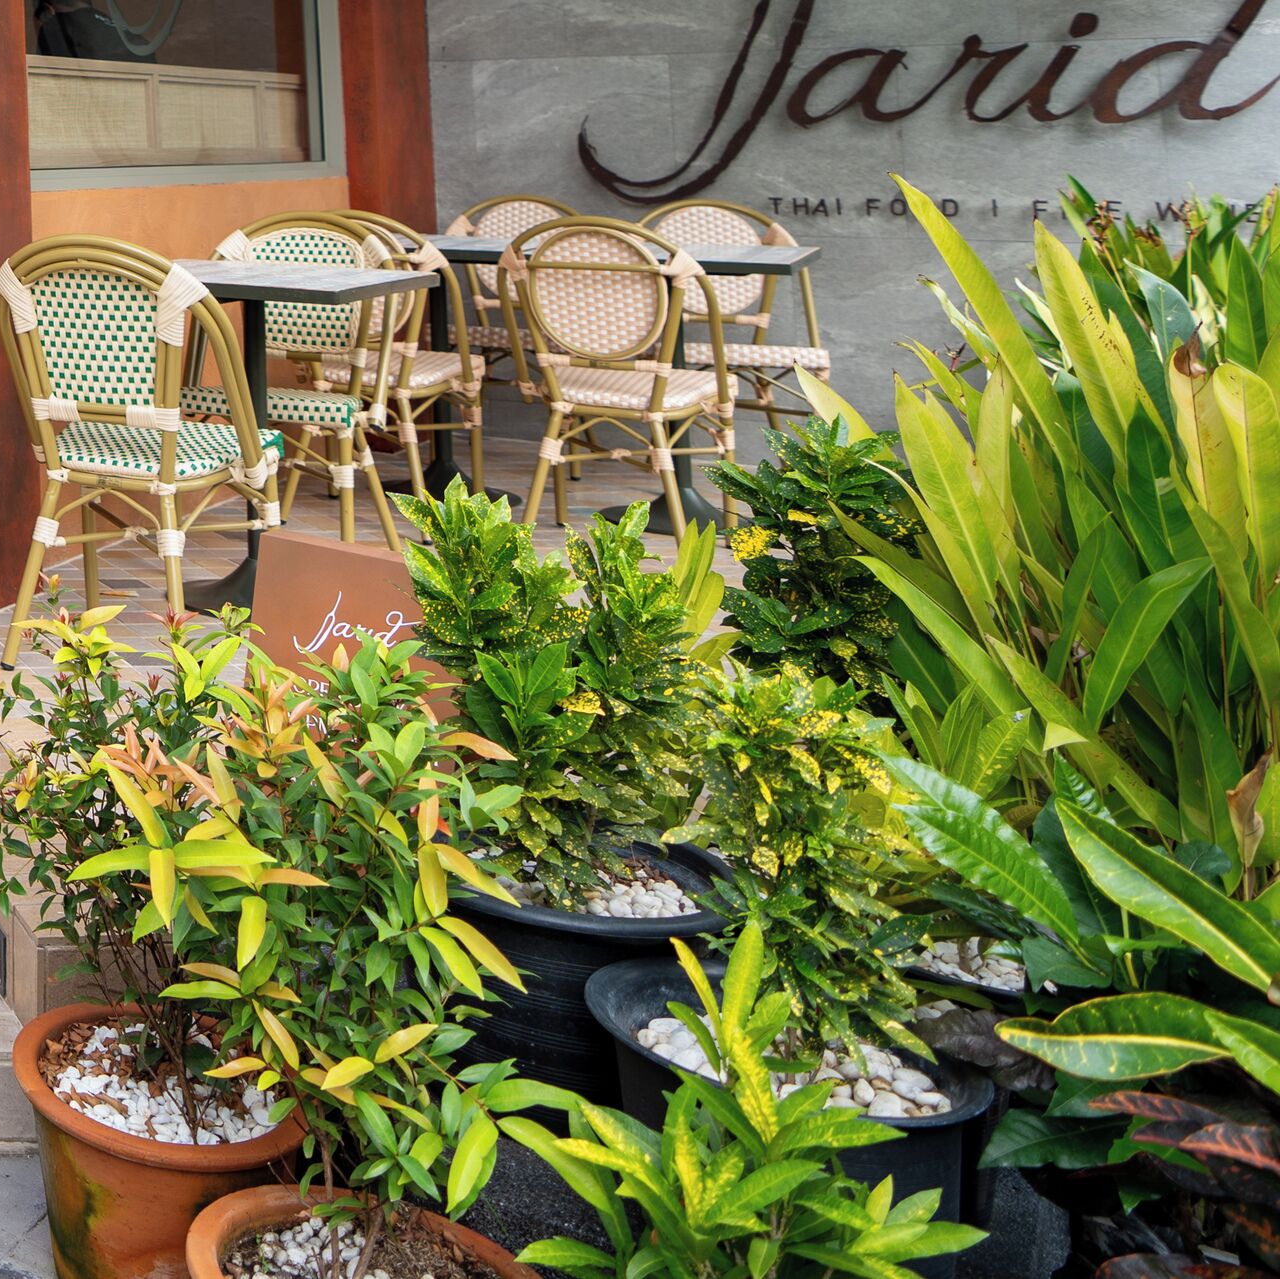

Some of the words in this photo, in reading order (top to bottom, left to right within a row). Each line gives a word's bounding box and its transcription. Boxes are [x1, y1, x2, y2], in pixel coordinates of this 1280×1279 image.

[767, 197, 842, 217] THAI
[866, 198, 959, 217] FOD
[1032, 199, 1123, 221] FE
